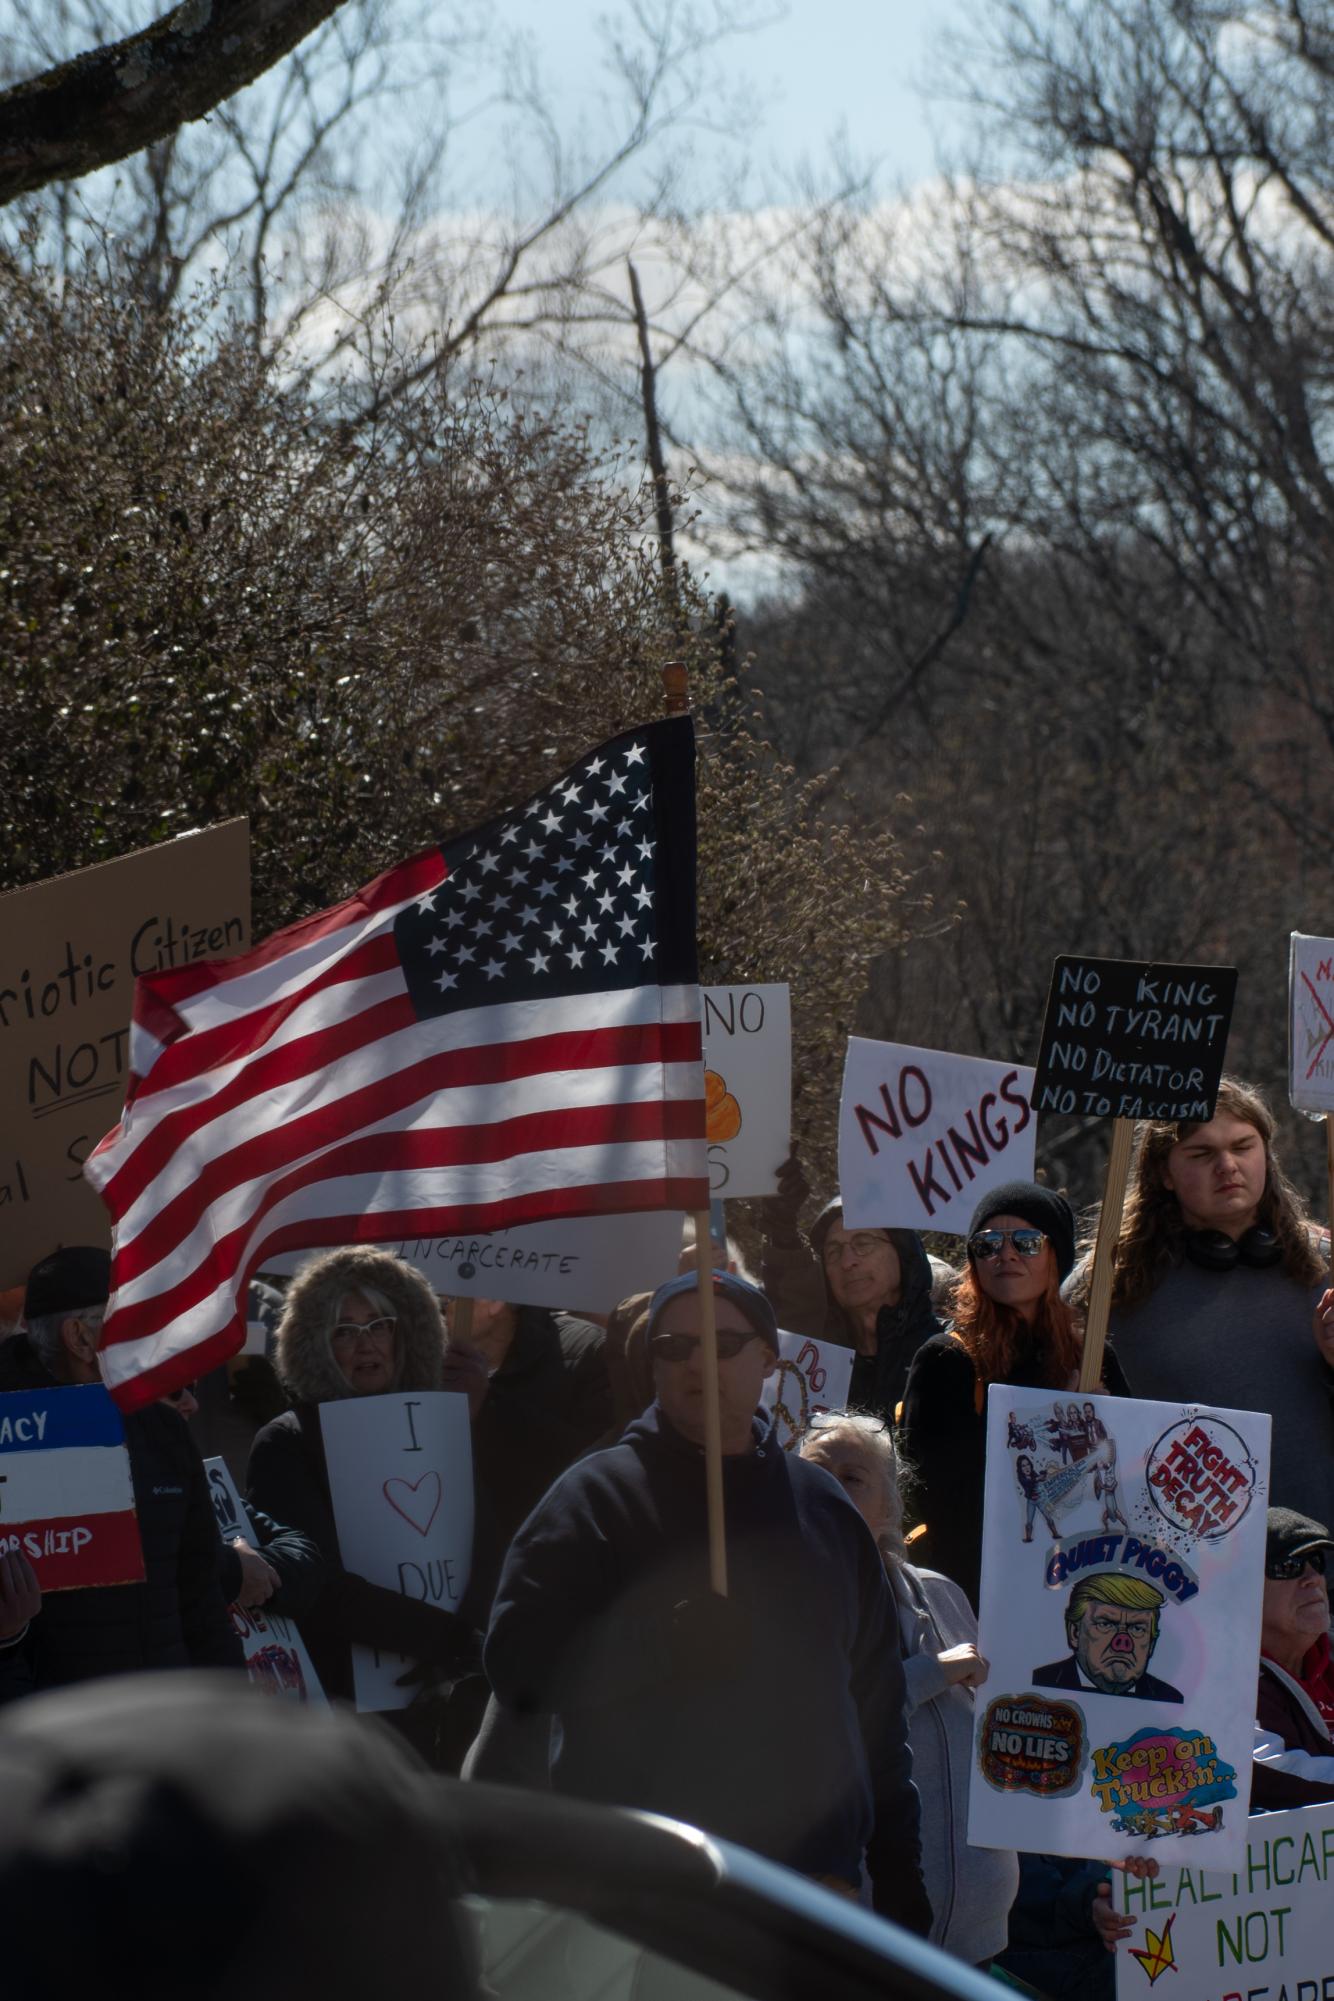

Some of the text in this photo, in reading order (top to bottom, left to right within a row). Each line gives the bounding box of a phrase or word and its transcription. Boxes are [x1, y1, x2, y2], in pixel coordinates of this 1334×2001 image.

[130, 916, 243, 977] Citizen
[1060, 965, 1217, 1007] NO KING
[704, 992, 764, 1036] NO
[1057, 1001, 1225, 1043] NO TYRANT
[29, 1027, 130, 1104] NOT
[1048, 1041, 1088, 1071] NO
[854, 1065, 932, 1156] NO
[1039, 1084, 1209, 1120] NO TO FASCISM
[907, 1070, 1031, 1217] KINGS
[395, 1238, 579, 1274] INCARCERATE
[403, 1401, 423, 1452] I
[1165, 1440, 1239, 1523] TRUTH
[1183, 1426, 1249, 1494] FIGHT
[1150, 1463, 1221, 1537] DECAY
[398, 1559, 458, 1602] DUE
[1047, 1535, 1199, 1602] QUIET PIGGY
[995, 1707, 1053, 1729] NO CROWNS
[991, 1731, 1070, 1762] NO LIES
[1091, 1736, 1214, 1780] Keep on
[1216, 1906, 1292, 1967] NOT
